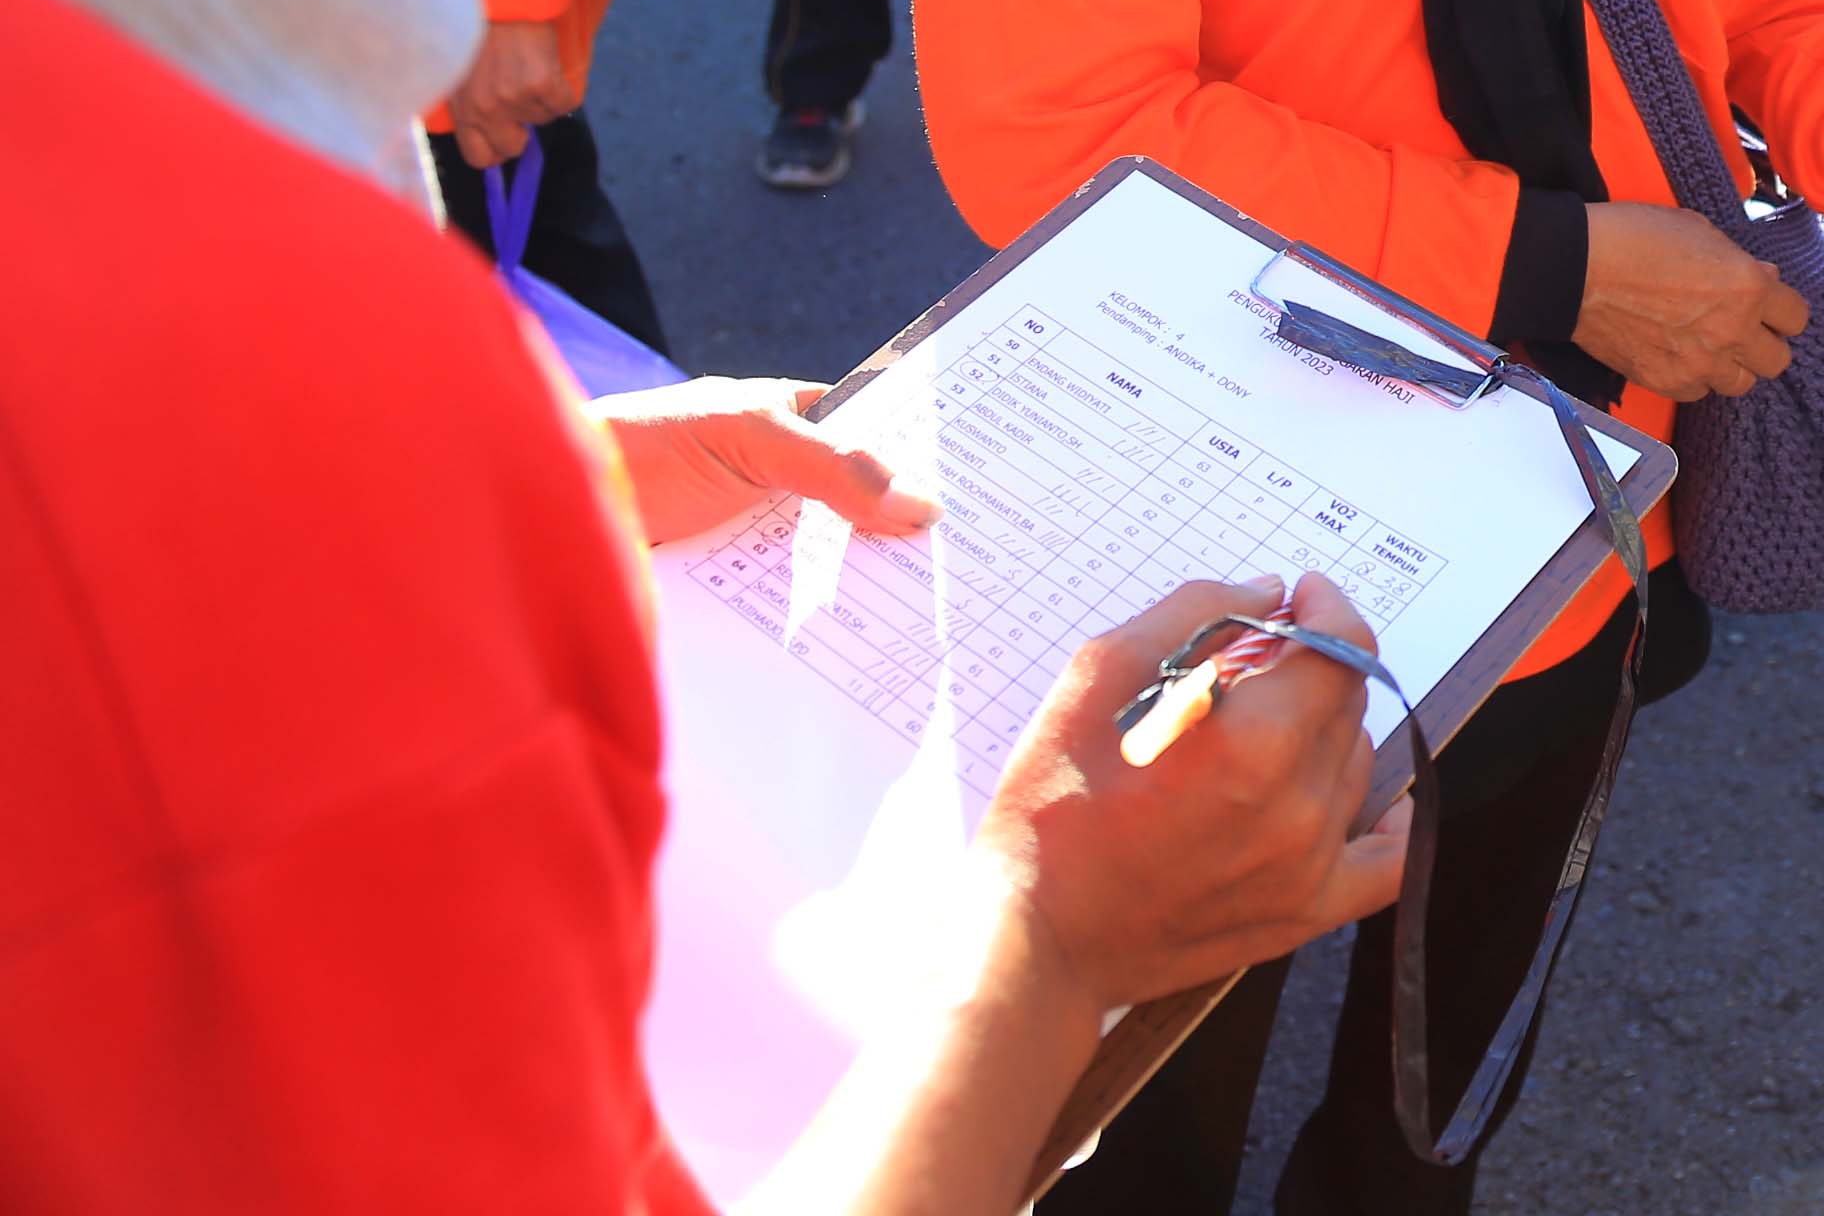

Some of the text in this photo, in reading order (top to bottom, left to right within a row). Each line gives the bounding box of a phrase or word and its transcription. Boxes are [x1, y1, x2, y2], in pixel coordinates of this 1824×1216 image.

[1109, 290, 1167, 332] KELOMPOK
[1096, 301, 1157, 344] Pendamping
[1163, 343, 1206, 376] ANDIKA
[1216, 374, 1252, 400] DONY
[1259, 326, 1335, 377] TAHUN 2023
[1024, 319, 1292, 489] NO NAMA USIA L/P
[1384, 382, 1415, 405] HAJI
[968, 368, 984, 380] 52
[991, 386, 1018, 410] DIDIK
[1160, 493, 1176, 505] 62
[987, 354, 1247, 522] 51 ISTIANA 63 P
[1005, 339, 1265, 505] 50 ENDANG WIDIYATI 63 P
[950, 383, 965, 395] 53
[973, 402, 1003, 424] ABDUL
[1003, 420, 1035, 445] KADIR
[1142, 508, 1158, 521] 62
[953, 417, 1008, 455] KUSWANTO
[1124, 525, 1140, 537] 62
[1314, 511, 1348, 534] MAX
[1329, 499, 1358, 521] VO2
[753, 543, 768, 555] 63
[1086, 558, 1102, 571] 62
[1105, 542, 1121, 554] 62
[1372, 543, 1420, 576] TEMPUH
[1385, 534, 1428, 564] WAKTU
[731, 559, 747, 572] 64
[953, 532, 996, 565] RAHARJO
[1048, 593, 1063, 606] 61
[1067, 575, 1082, 588] 61
[774, 526, 789, 540] 62
[968, 664, 983, 677] 61
[1028, 610, 1043, 623] 61
[1008, 628, 1023, 641] 61
[710, 575, 725, 588] 65
[905, 720, 922, 734] 60
[988, 646, 1003, 659] 61
